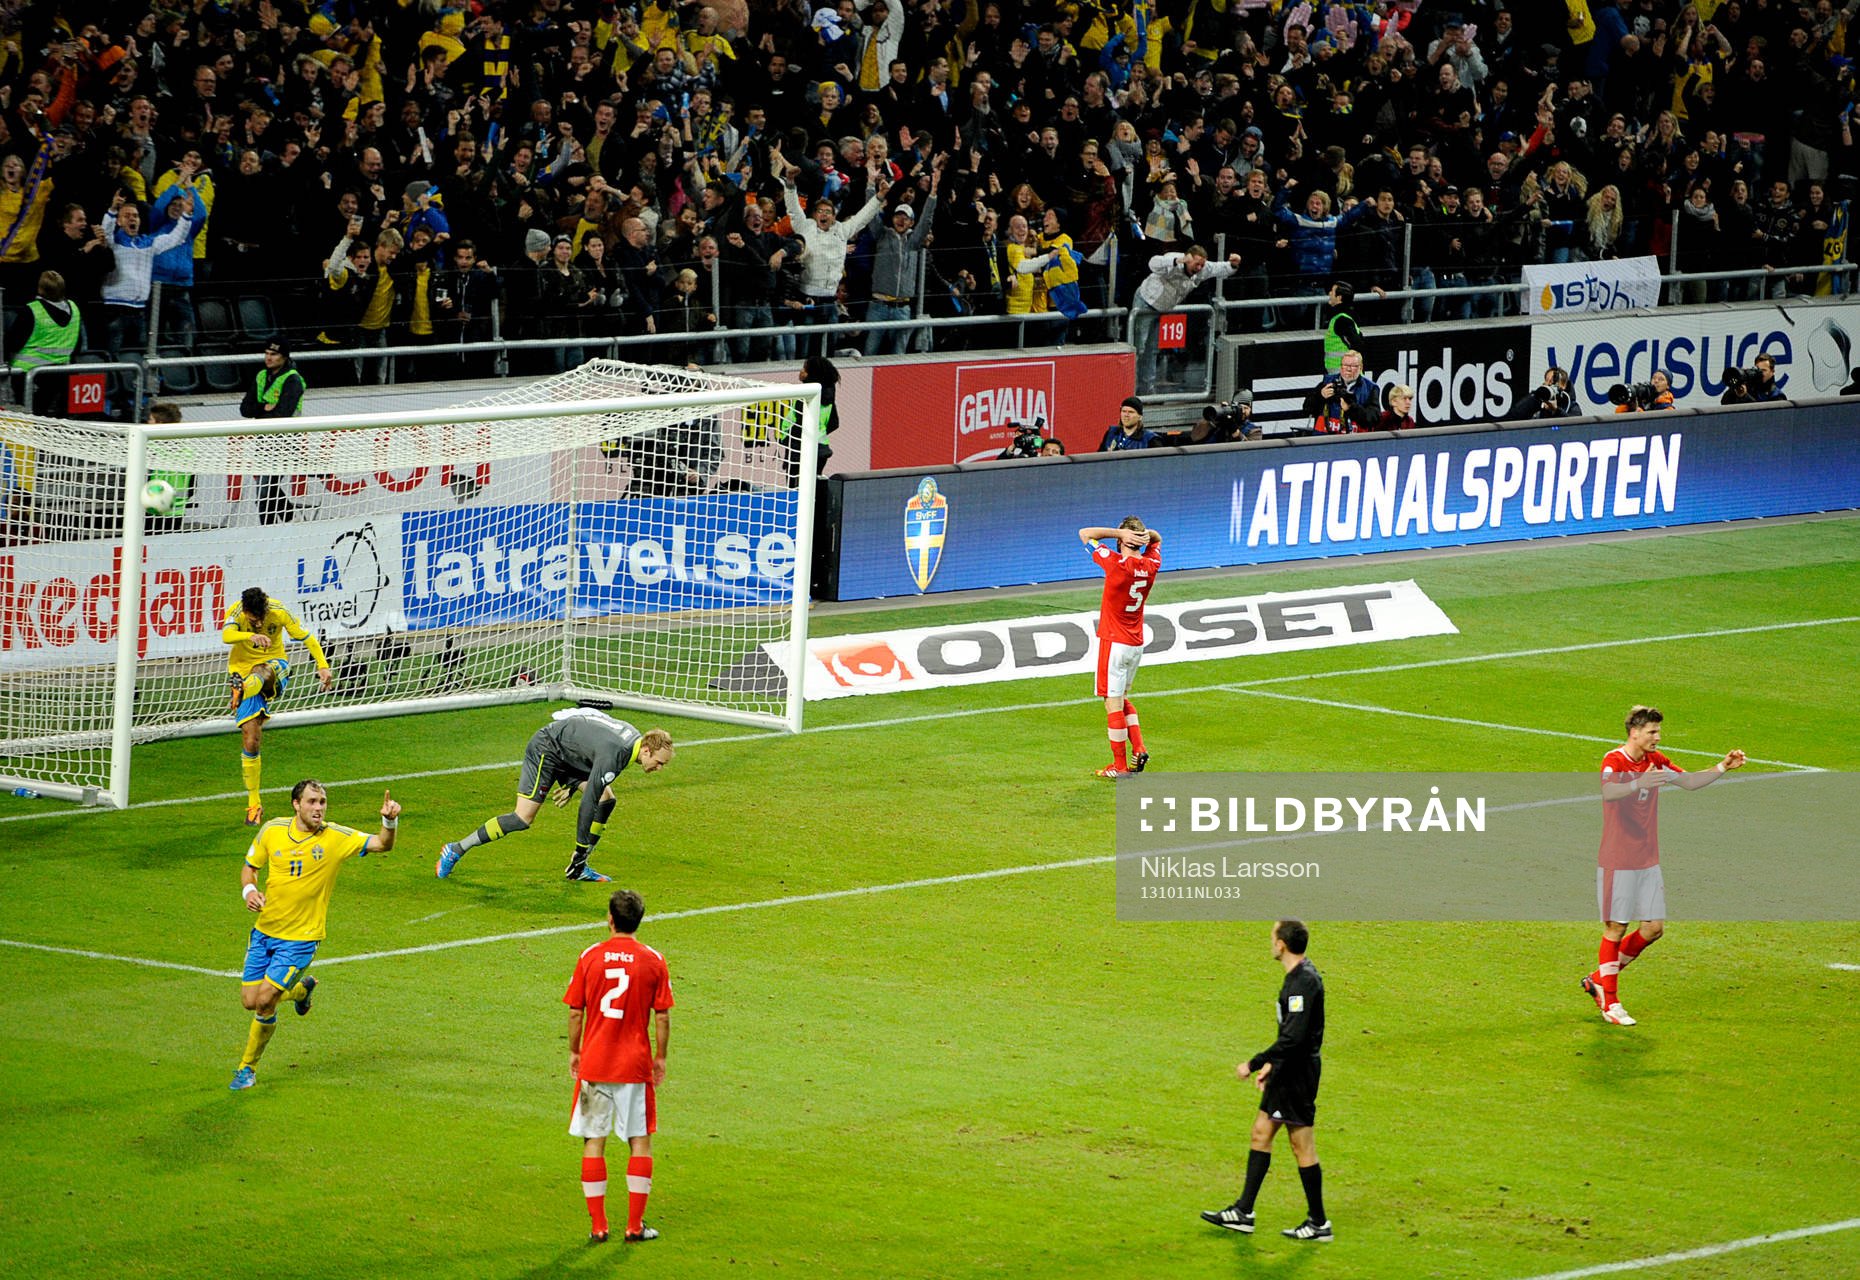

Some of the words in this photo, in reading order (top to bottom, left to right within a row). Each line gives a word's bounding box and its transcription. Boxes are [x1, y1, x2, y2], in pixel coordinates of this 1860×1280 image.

[1162, 322, 1184, 341] 119
[1365, 348, 1512, 424] didas
[1547, 331, 1793, 404] verisure
[72, 383, 102, 404] 120
[960, 387, 1049, 435] GEVALIA
[297, 555, 343, 594] LA
[414, 525, 796, 600] latravel.se
[298, 594, 357, 622] Travel
[1125, 580, 1147, 612] 5
[290, 860, 302, 877] 11
[600, 967, 630, 1020] 2
